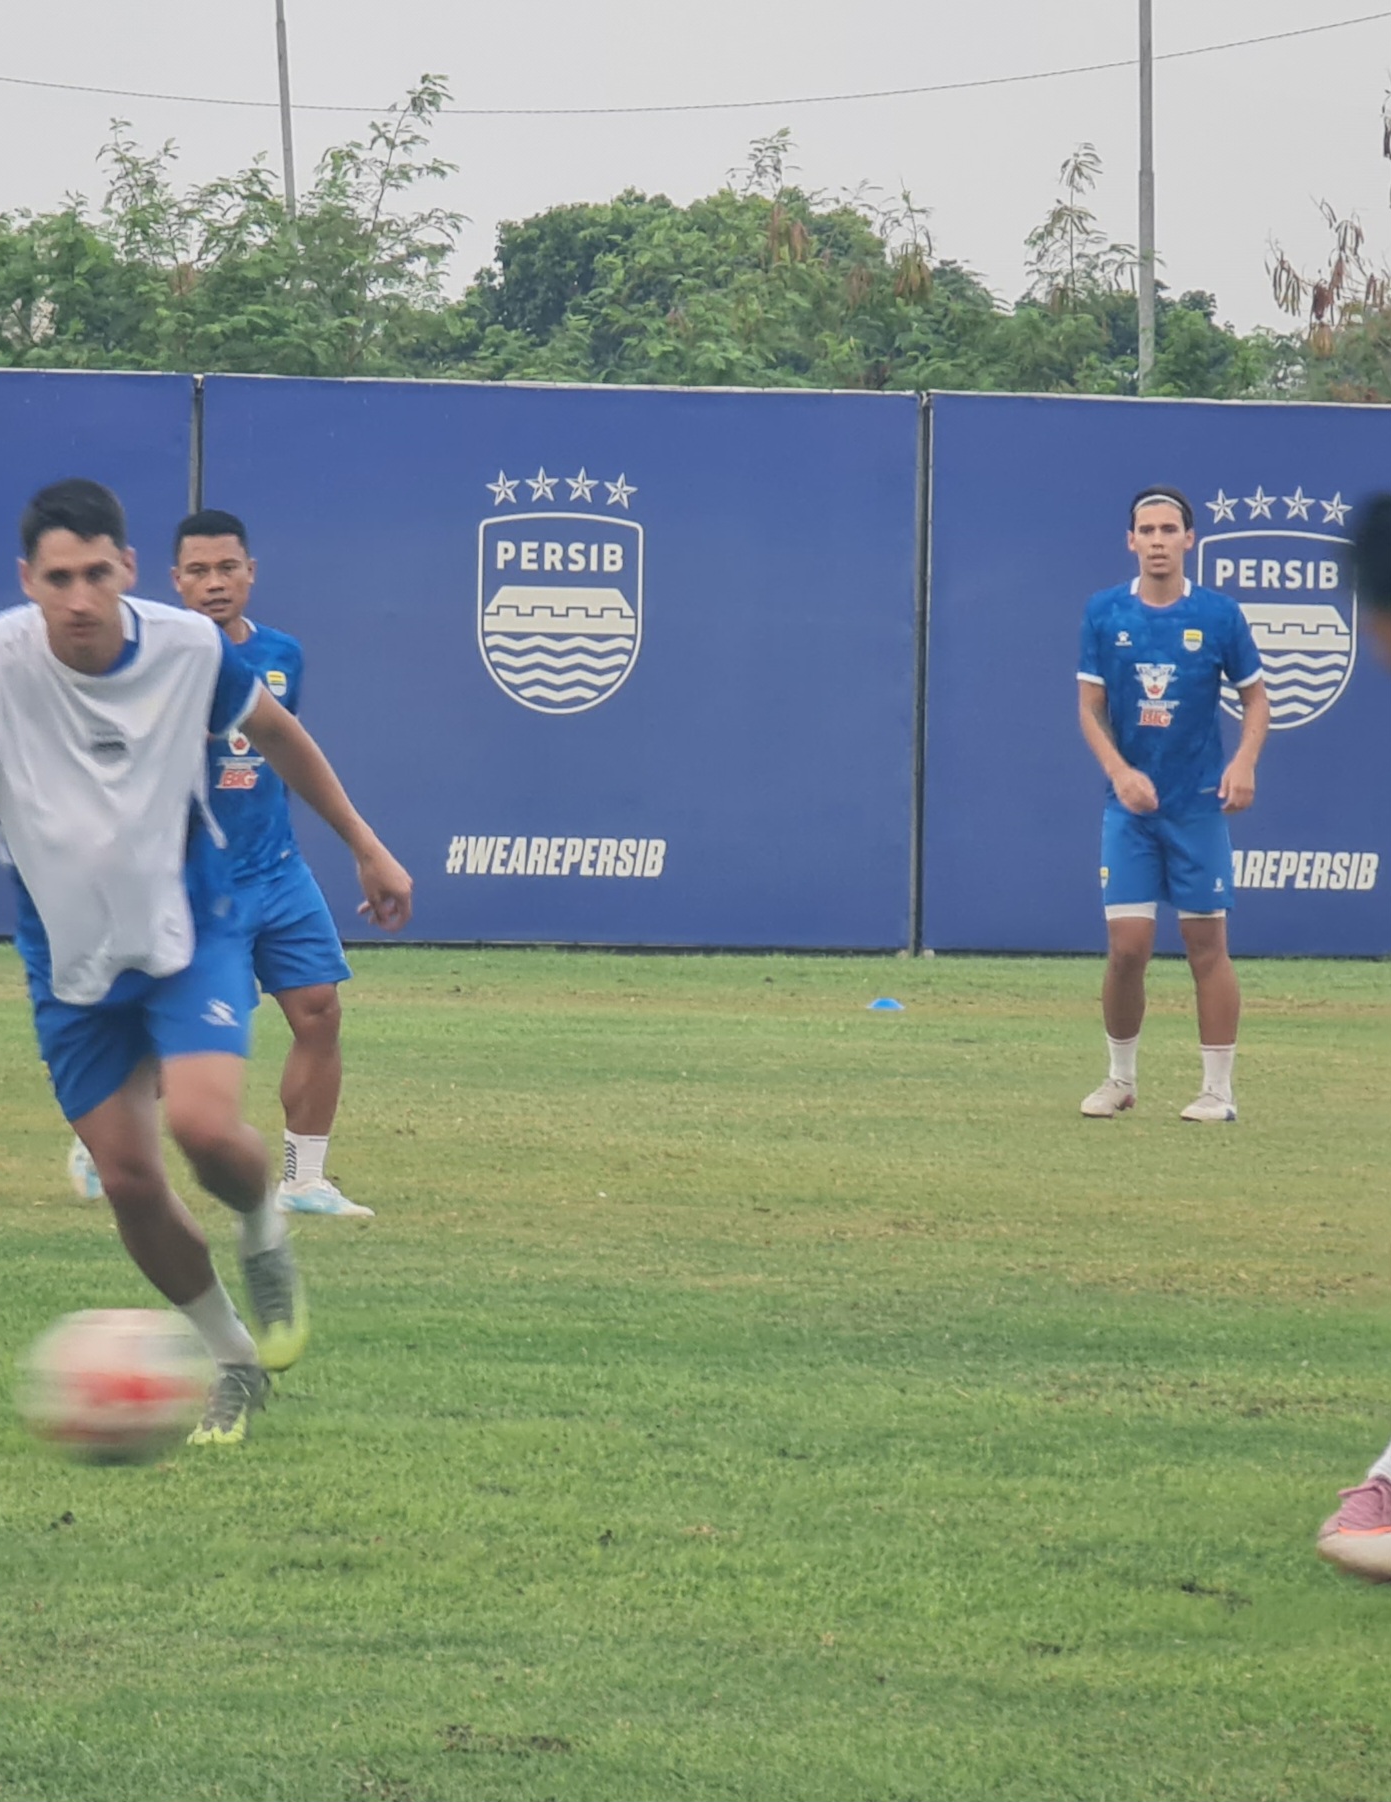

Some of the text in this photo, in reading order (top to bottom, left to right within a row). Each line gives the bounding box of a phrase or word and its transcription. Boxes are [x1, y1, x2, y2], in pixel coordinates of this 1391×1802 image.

[496, 540, 625, 572] PERSIB
[1215, 558, 1340, 590] PERSIB
[218, 769, 258, 789] BIG
[446, 836, 667, 878] #WEAREPERSIB
[1231, 850, 1380, 891] AREPERSIB
